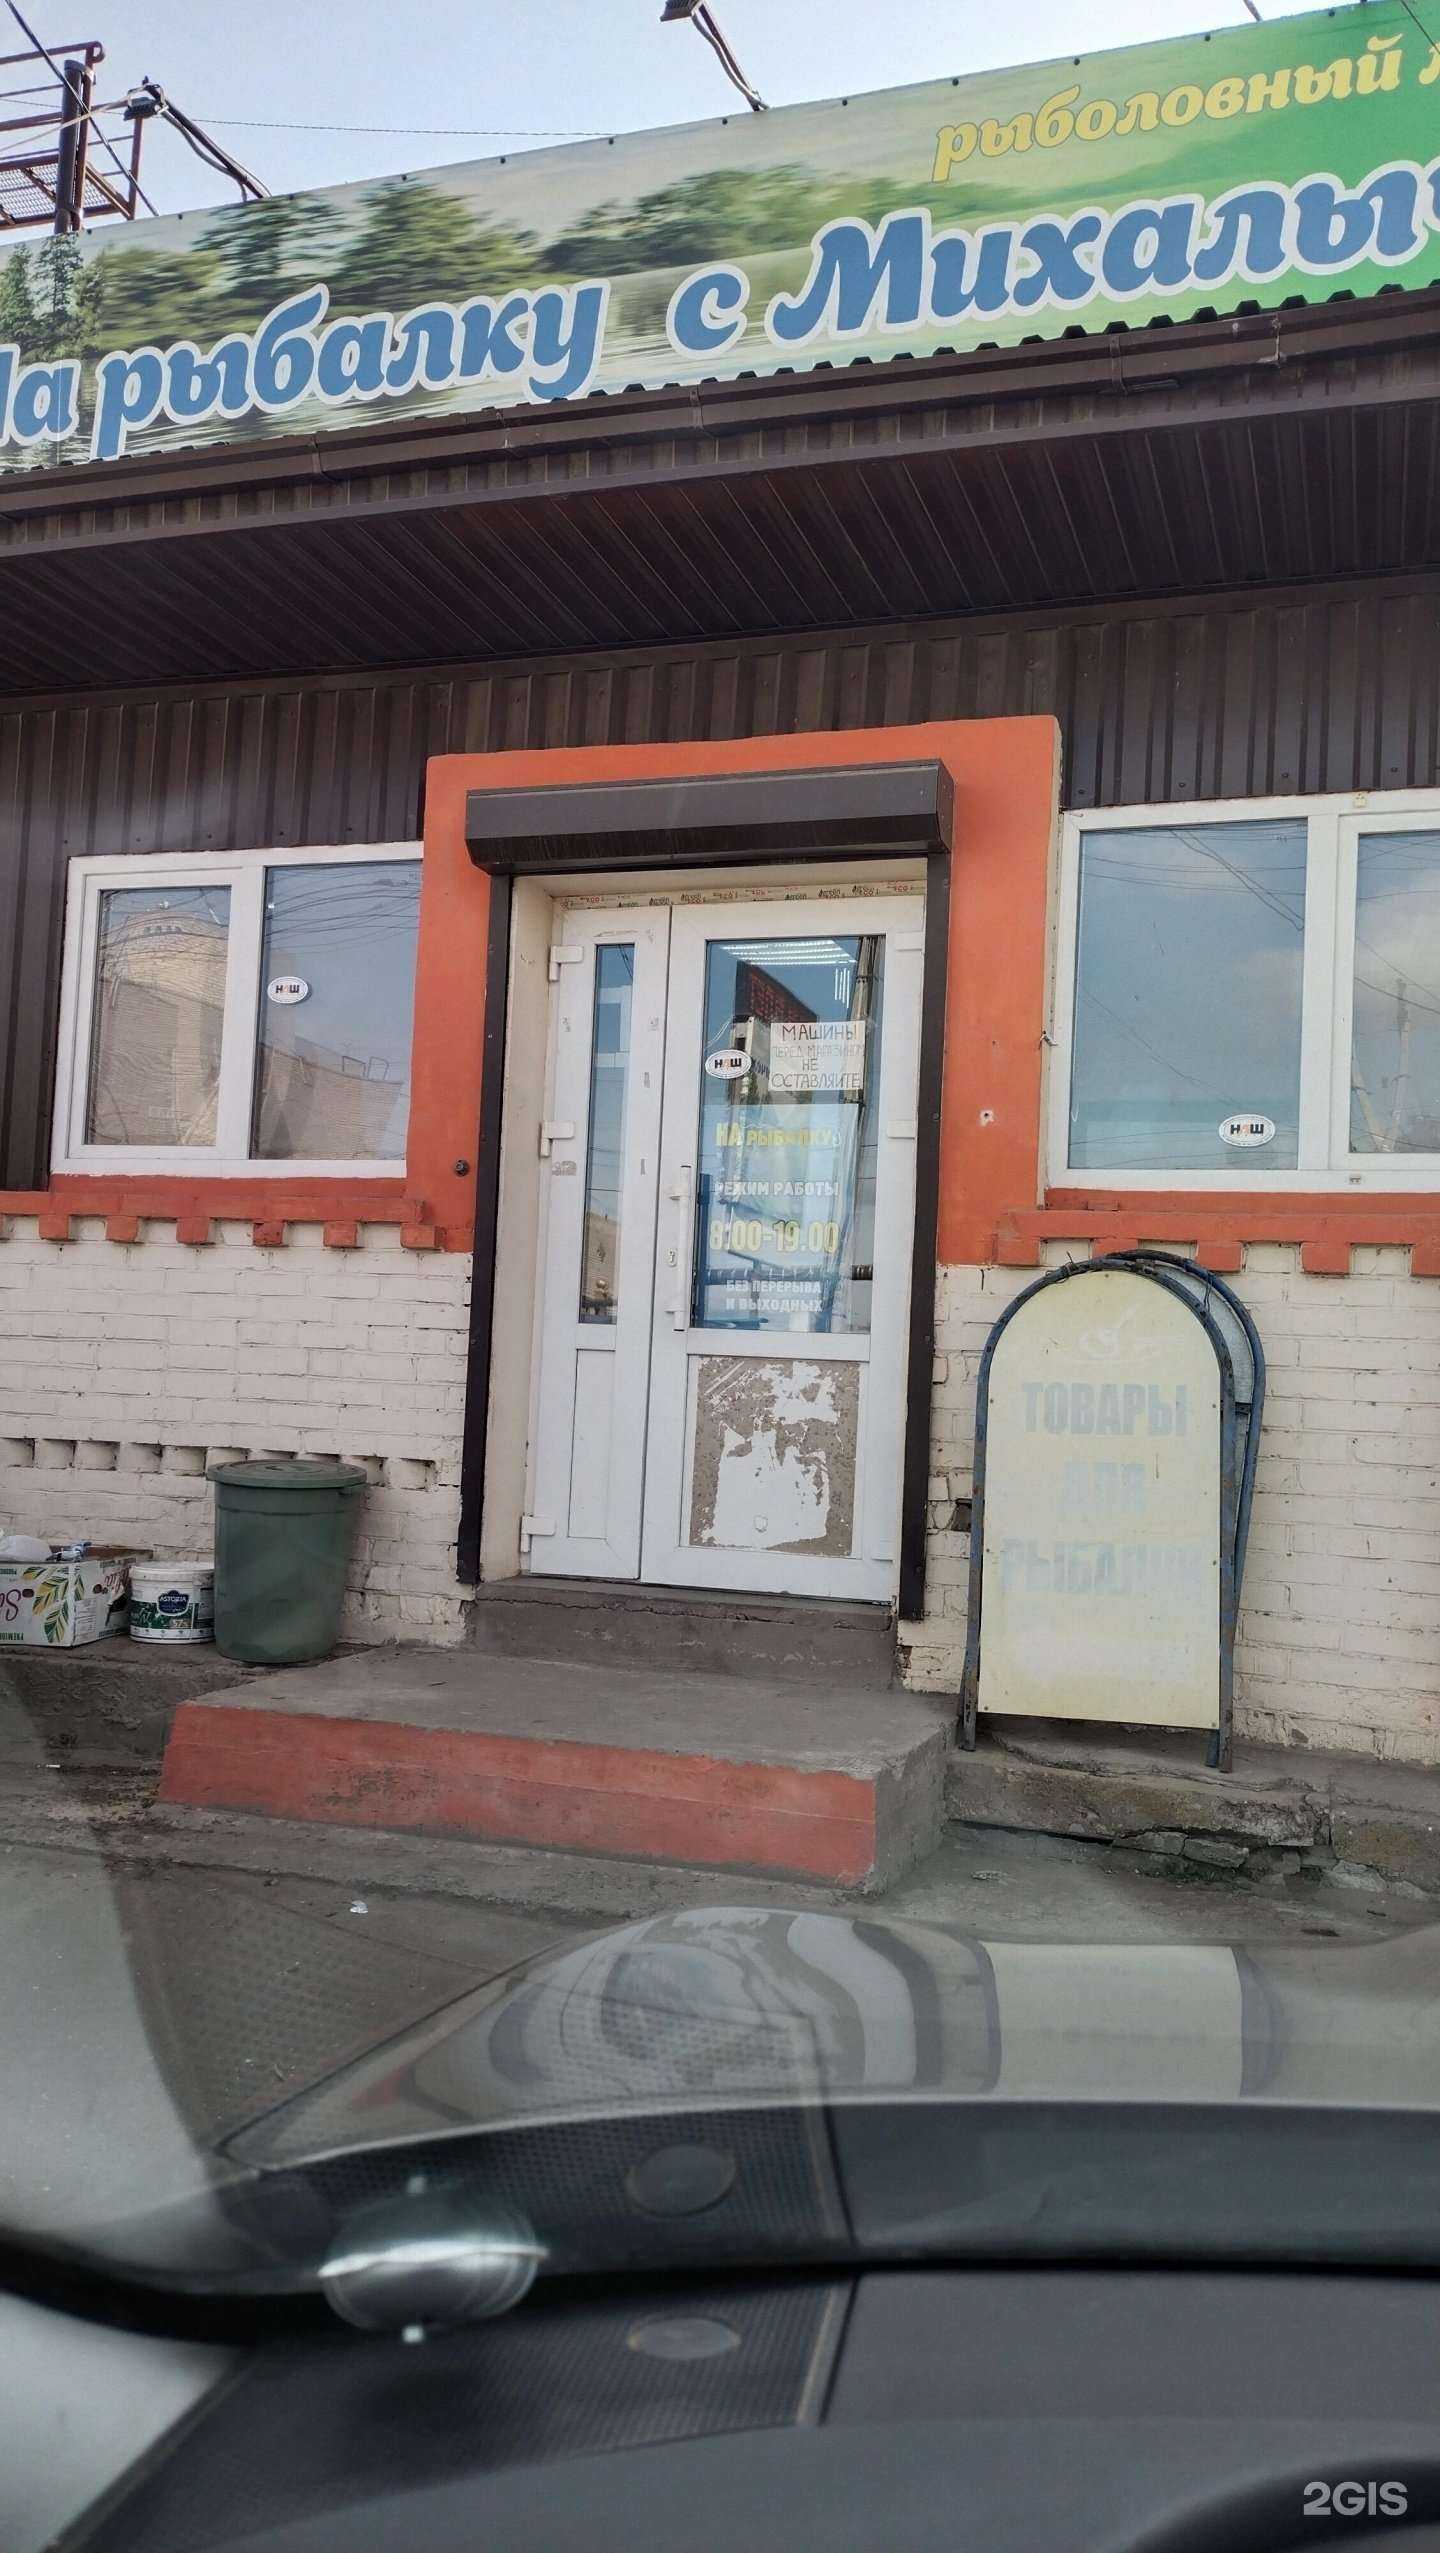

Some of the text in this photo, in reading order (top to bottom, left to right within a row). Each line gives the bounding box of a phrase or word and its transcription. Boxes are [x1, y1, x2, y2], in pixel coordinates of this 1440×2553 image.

[932, 34, 1403, 183] рыболовный
[93, 283, 608, 459] рыбалку
[668, 265, 749, 358] с
[782, 1024, 857, 1041] МАШИНЫ
[802, 1058, 818, 1071] НЕ
[726, 1280, 749, 1292] БЕЗ
[1022, 1381, 1188, 1437] ТОВАРЫ
